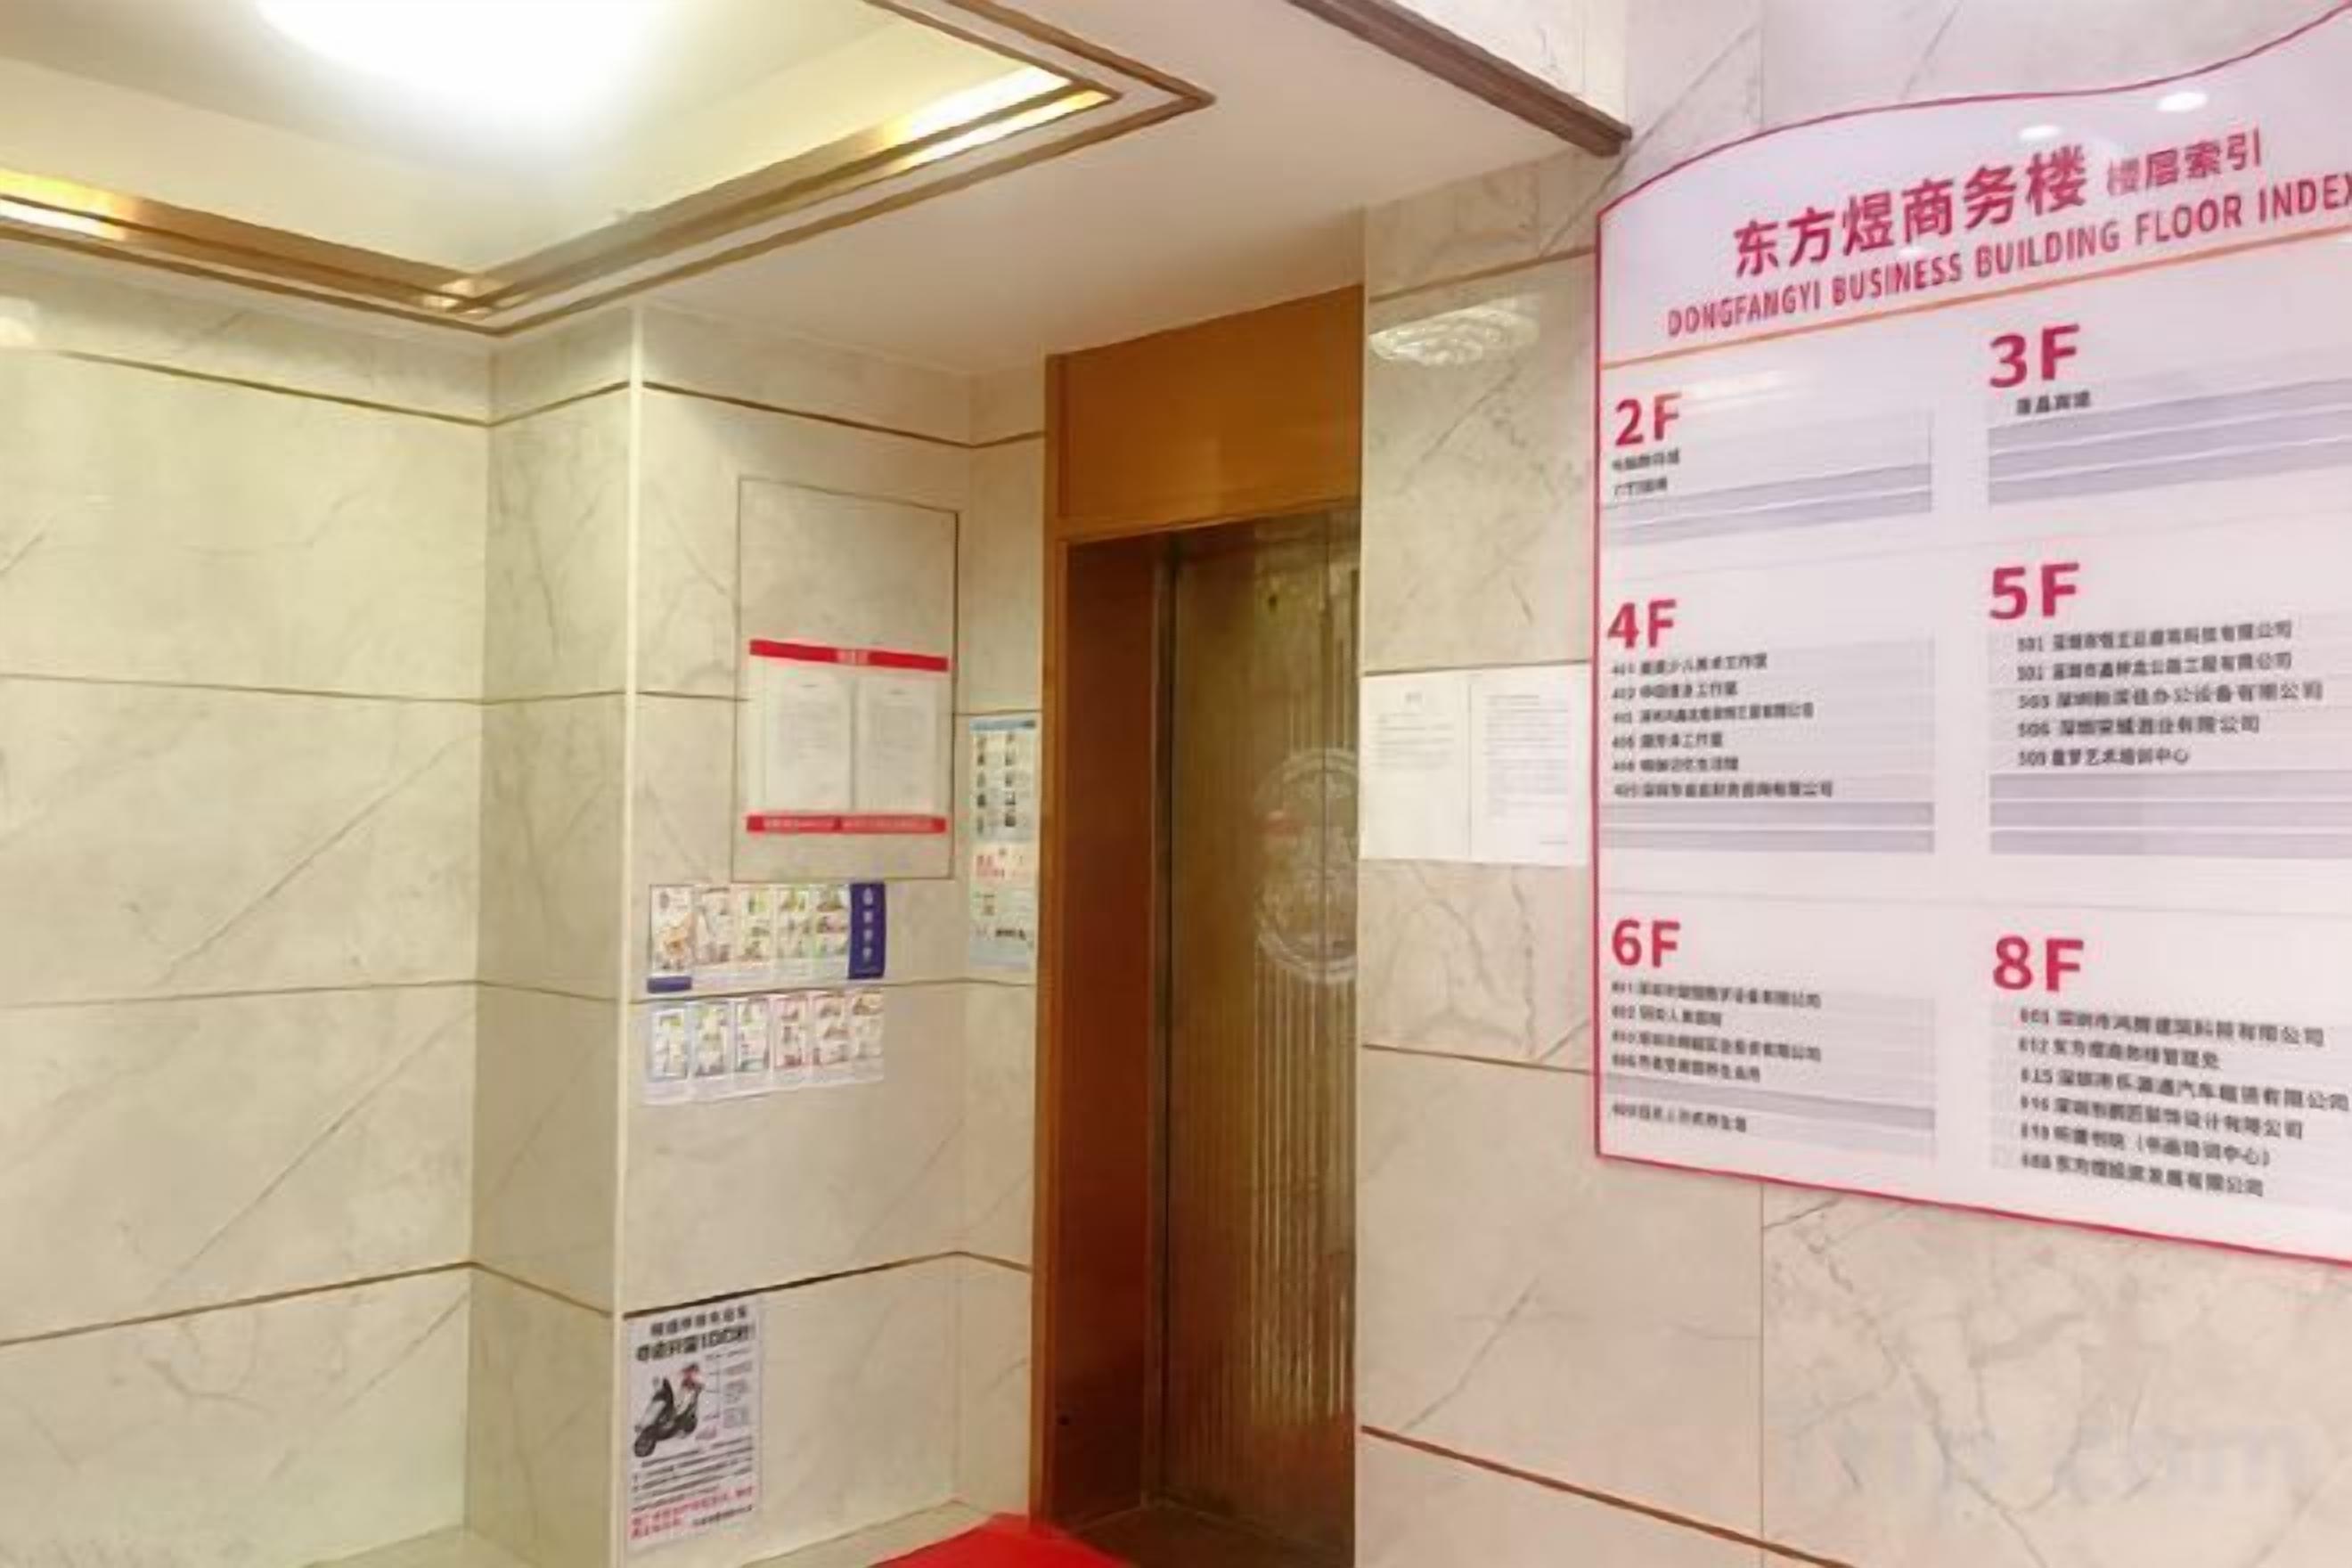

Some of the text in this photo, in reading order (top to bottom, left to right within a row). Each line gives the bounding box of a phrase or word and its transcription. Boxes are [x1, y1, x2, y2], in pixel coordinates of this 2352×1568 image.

[1733, 144, 2087, 278] 东方煜商务楼
[1668, 281, 1820, 337] DONGFANGYI
[1832, 252, 1962, 306] BUSINESS
[1975, 220, 2120, 278] BUILDING
[2136, 192, 2242, 246] FLOOR
[1989, 323, 2080, 388] 3F
[1614, 392, 1682, 445] 2F
[1989, 563, 2079, 619] 5F
[1607, 600, 1677, 649] 4F
[1612, 919, 1681, 968] 6F
[1992, 935, 2084, 992] 8F
